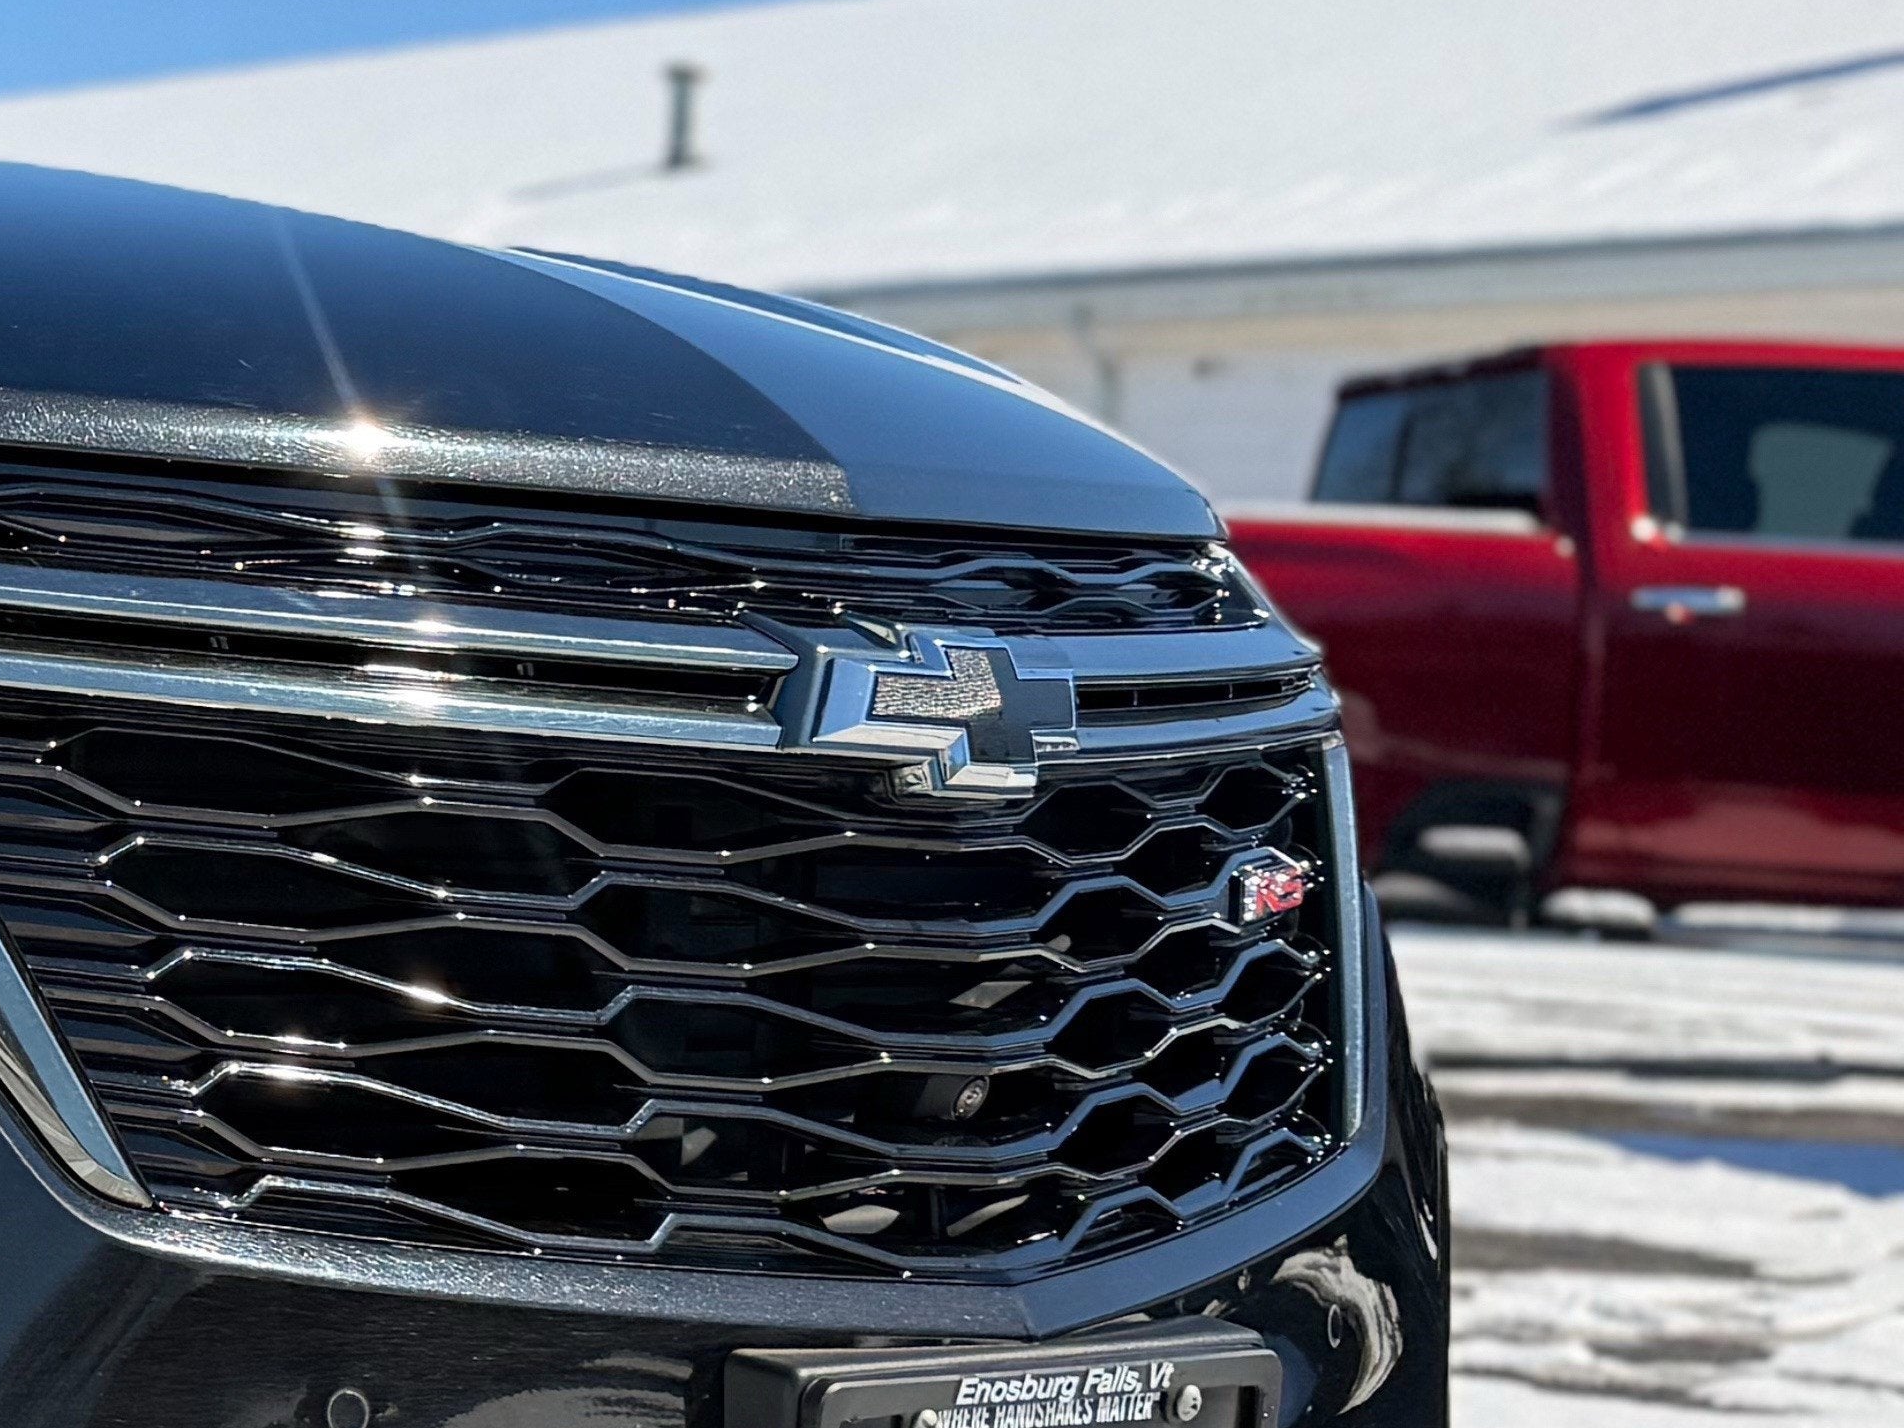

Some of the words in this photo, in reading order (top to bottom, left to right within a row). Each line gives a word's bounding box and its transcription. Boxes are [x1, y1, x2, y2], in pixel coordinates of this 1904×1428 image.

[955, 1372, 1081, 1406] Enosburg
[1083, 1364, 1143, 1395] Falls,
[1149, 1360, 1175, 1389] Vt
